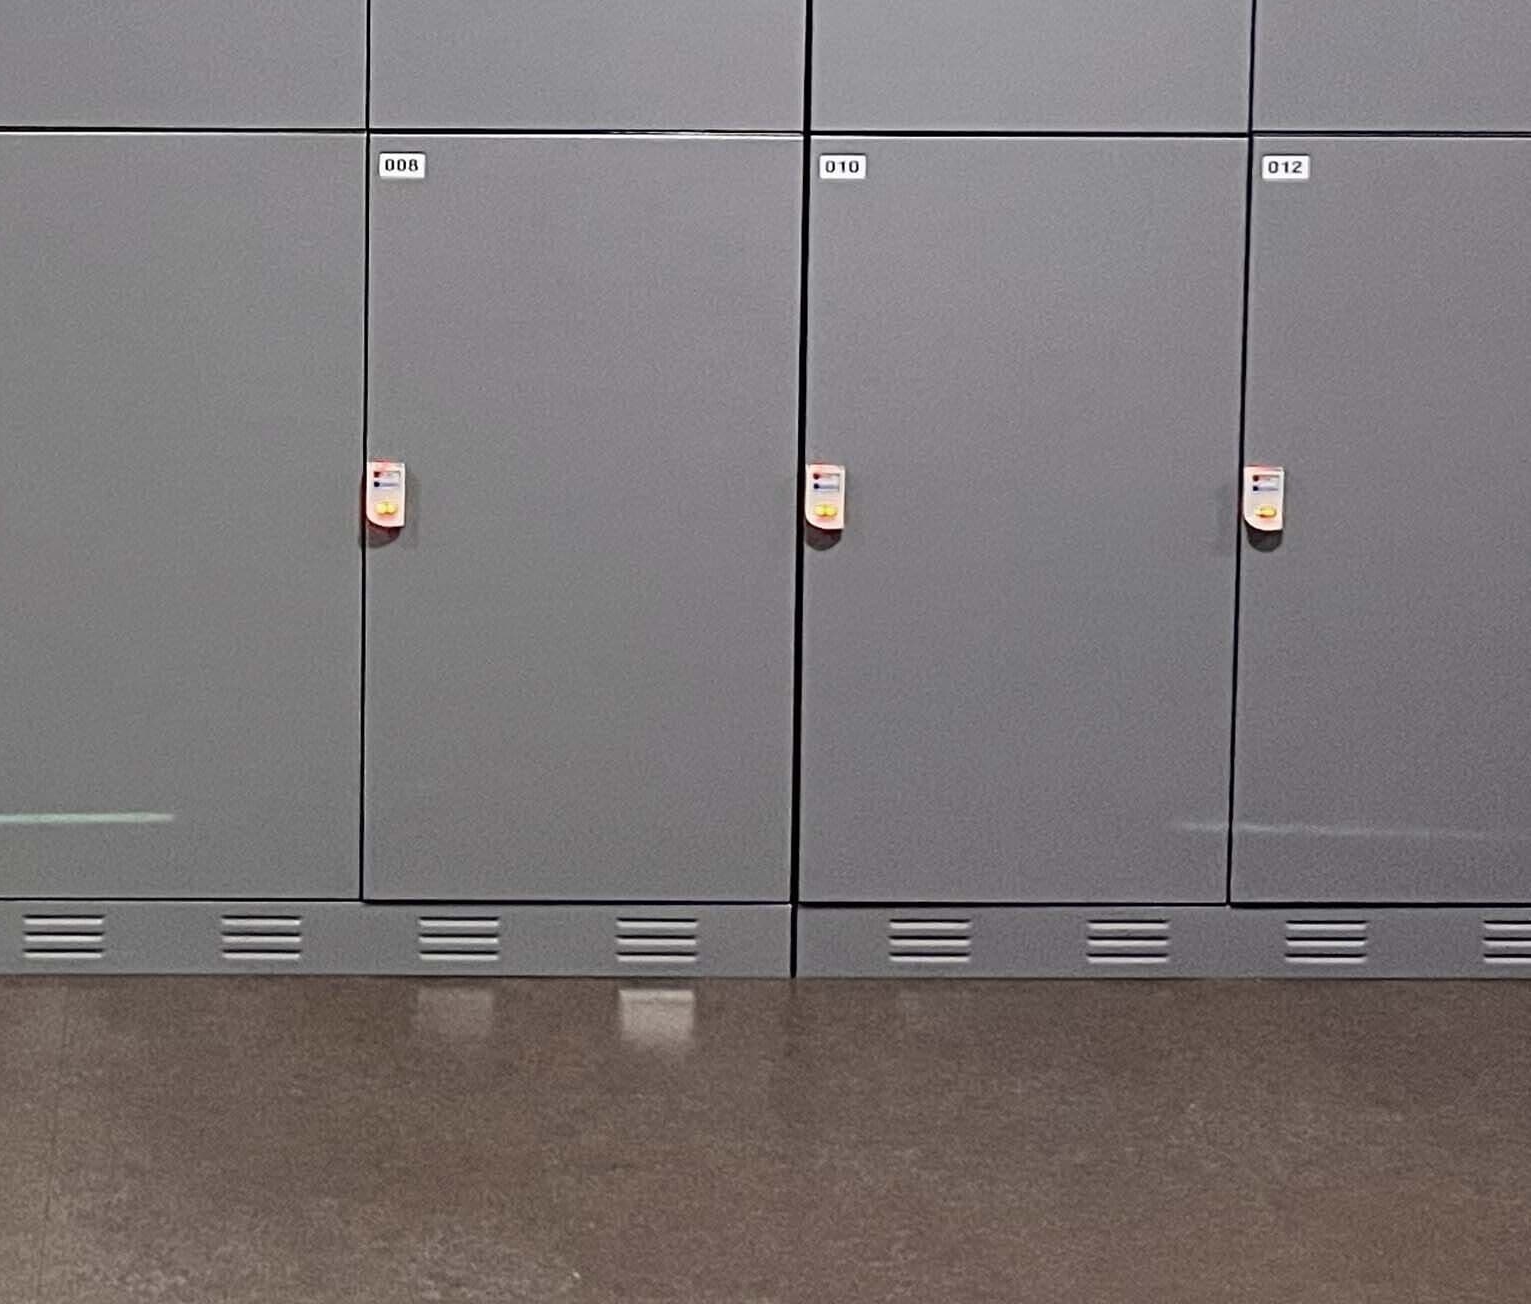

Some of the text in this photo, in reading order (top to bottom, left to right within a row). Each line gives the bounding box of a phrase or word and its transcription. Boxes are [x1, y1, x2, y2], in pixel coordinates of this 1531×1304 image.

[385, 159, 419, 172] 008
[825, 161, 860, 174] 010
[1268, 161, 1303, 174] 012
